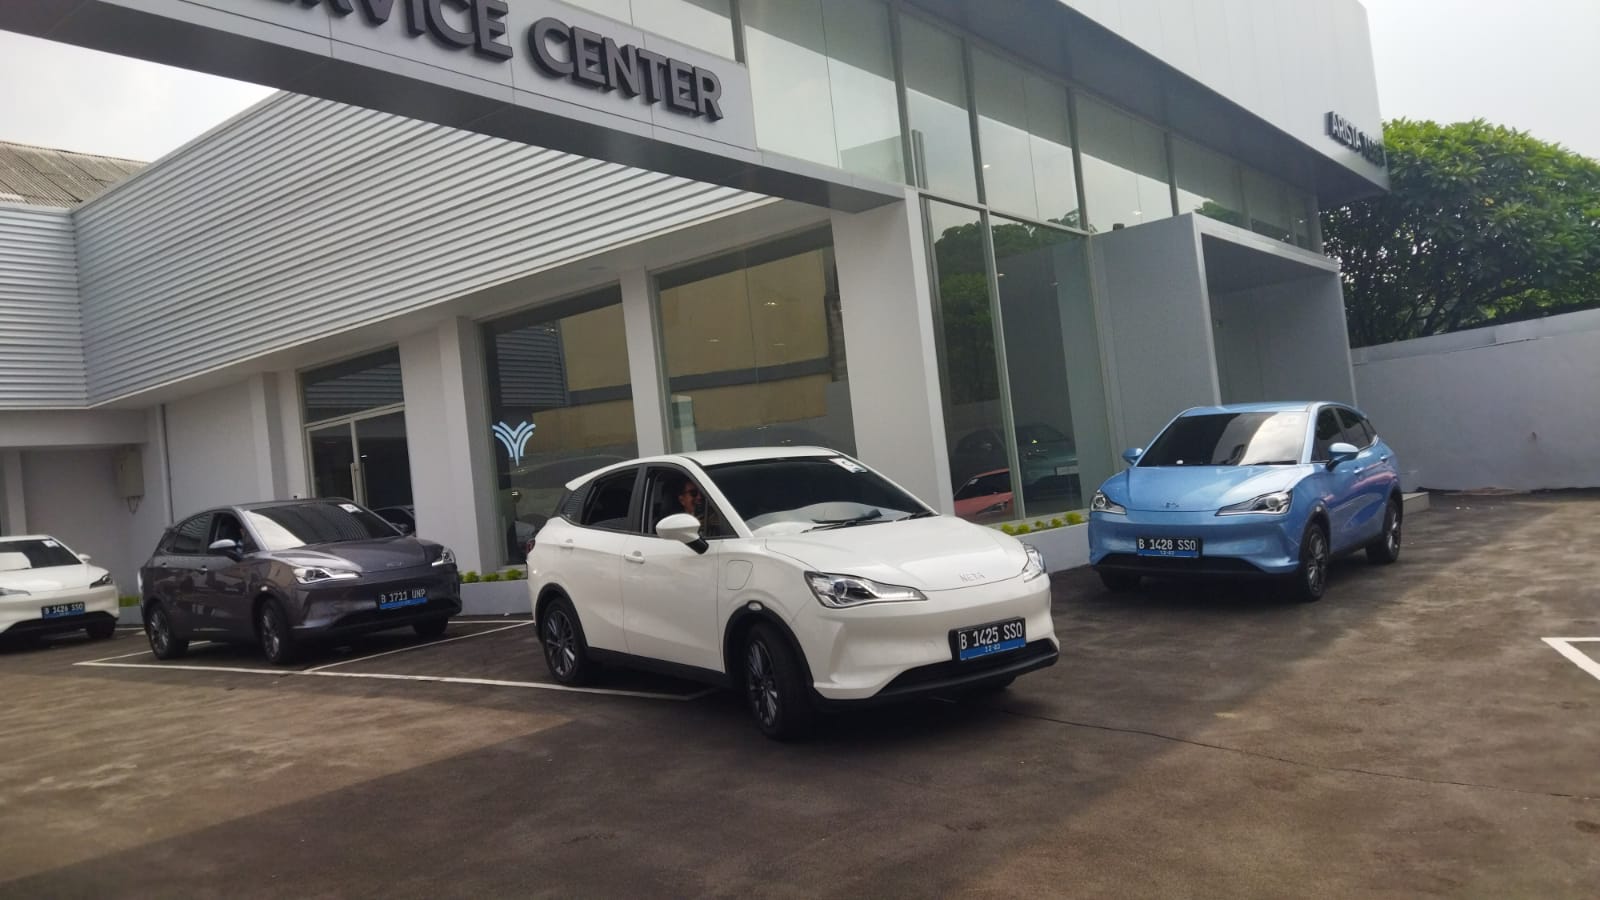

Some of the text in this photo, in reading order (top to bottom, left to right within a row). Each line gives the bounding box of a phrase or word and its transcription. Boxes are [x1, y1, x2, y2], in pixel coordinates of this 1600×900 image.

[528, 16, 724, 121] CENTER
[1138, 538, 1145, 550] B
[1149, 539, 1173, 551] 1428
[960, 622, 1023, 650] B 1425 SSO
